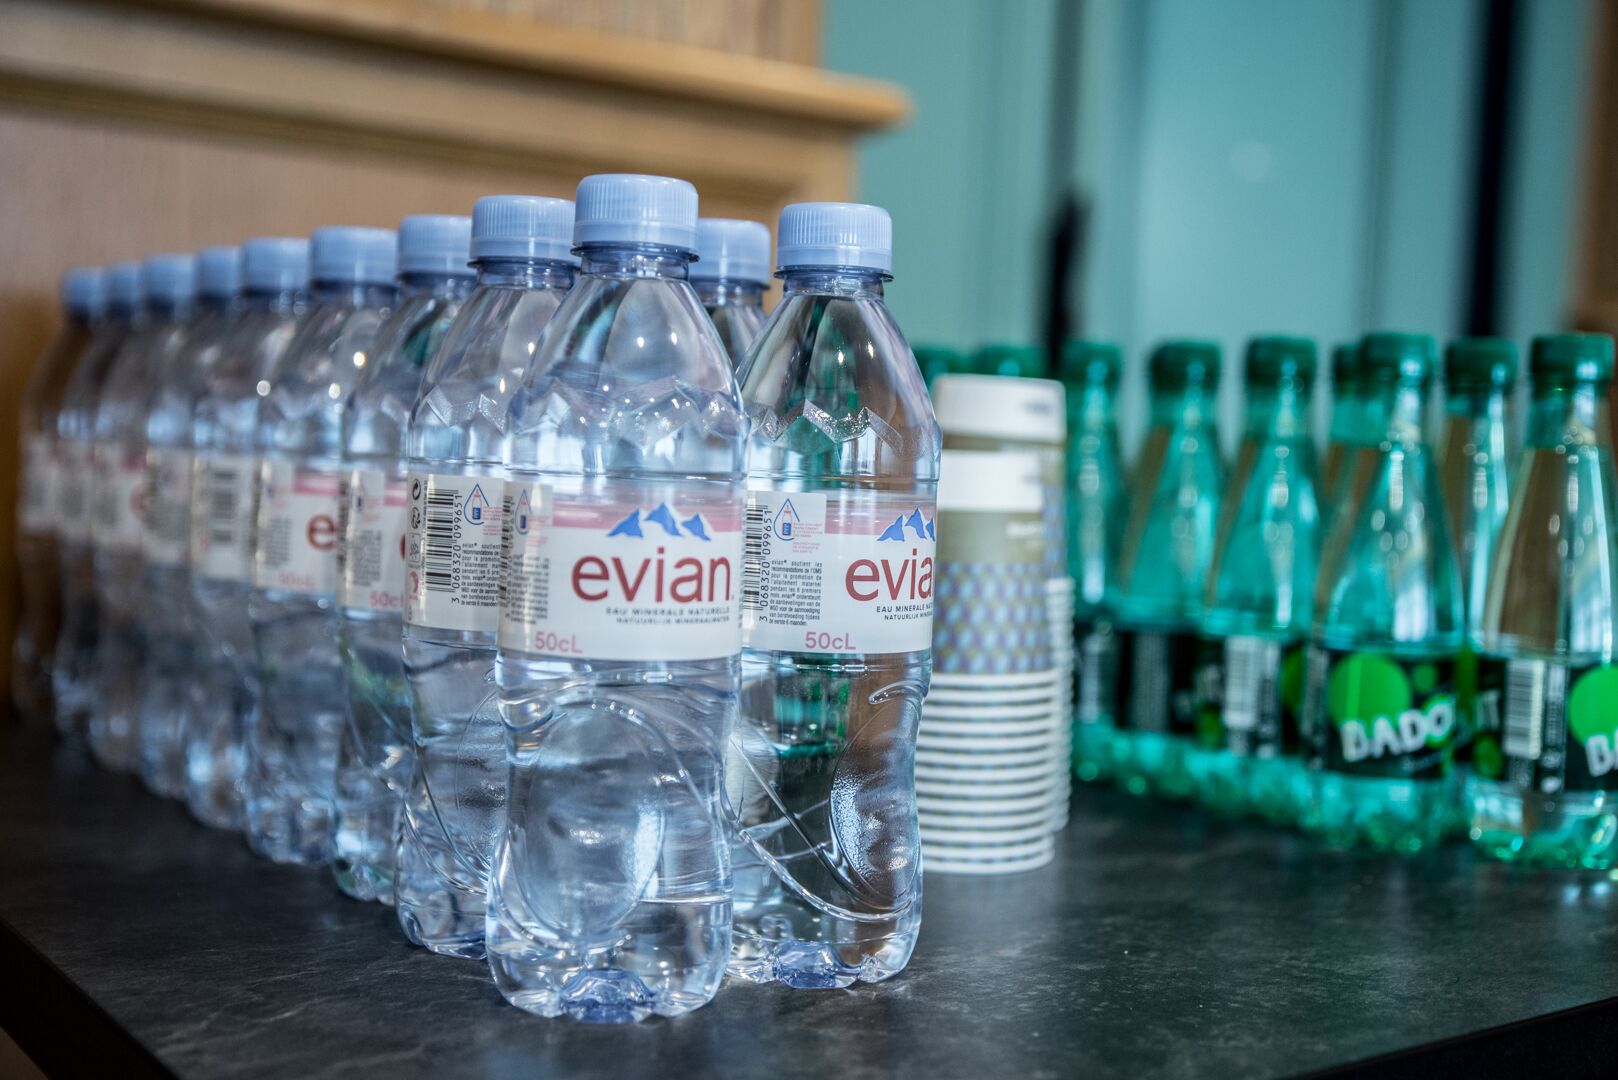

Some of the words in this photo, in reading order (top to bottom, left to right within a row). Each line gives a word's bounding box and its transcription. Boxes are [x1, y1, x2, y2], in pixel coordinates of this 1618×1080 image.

[453, 495, 463, 539] 099651
[762, 509, 772, 555] 099651
[452, 544, 461, 589] 068320
[571, 547, 731, 603] evian
[760, 561, 770, 607] 068320
[845, 548, 933, 602] evia
[876, 605, 893, 613] EAU
[895, 604, 925, 612] MINERALE
[535, 630, 583, 654] 50cL
[804, 631, 857, 650] 50cL
[1341, 703, 1455, 763] BADO
